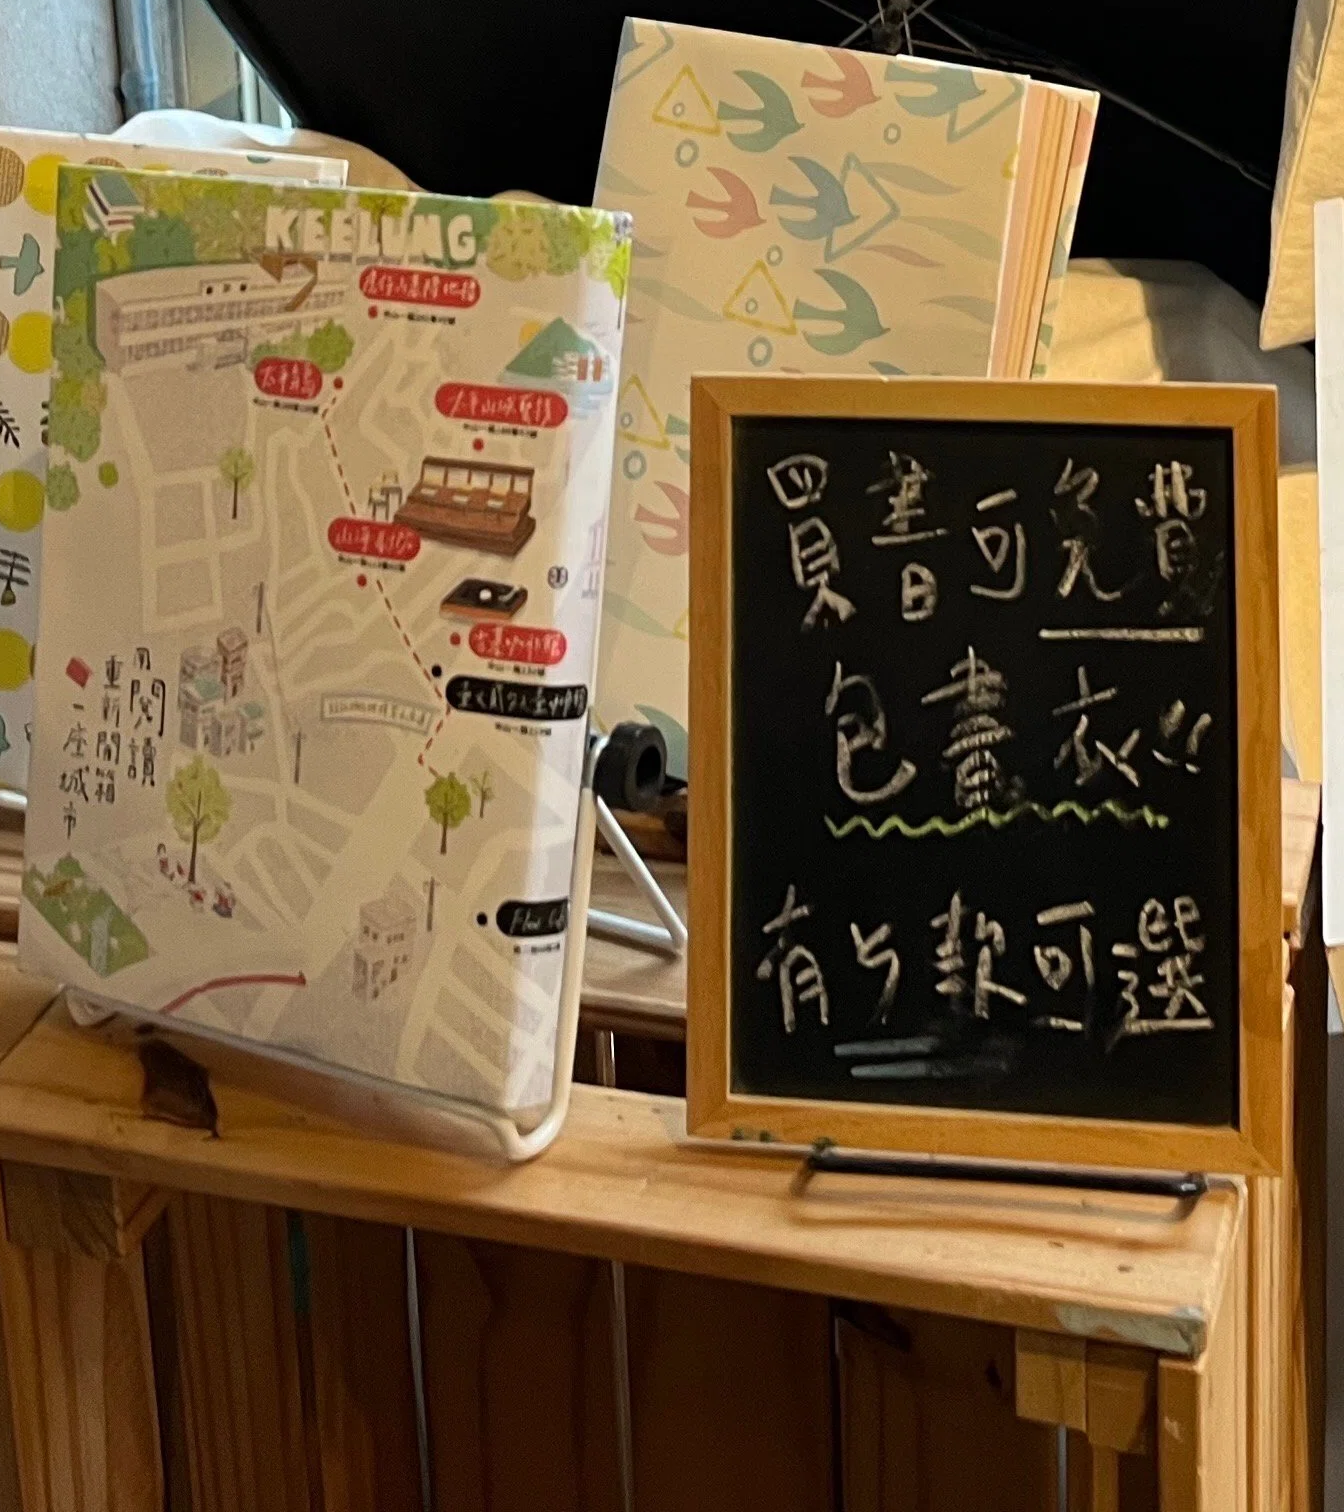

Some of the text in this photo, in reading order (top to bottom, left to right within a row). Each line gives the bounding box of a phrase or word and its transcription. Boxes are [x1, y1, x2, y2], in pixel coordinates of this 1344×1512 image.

[264, 206, 478, 263] KEELUNG
[768, 451, 1207, 631] 買書可免費
[59, 703, 90, 840] 一座城市
